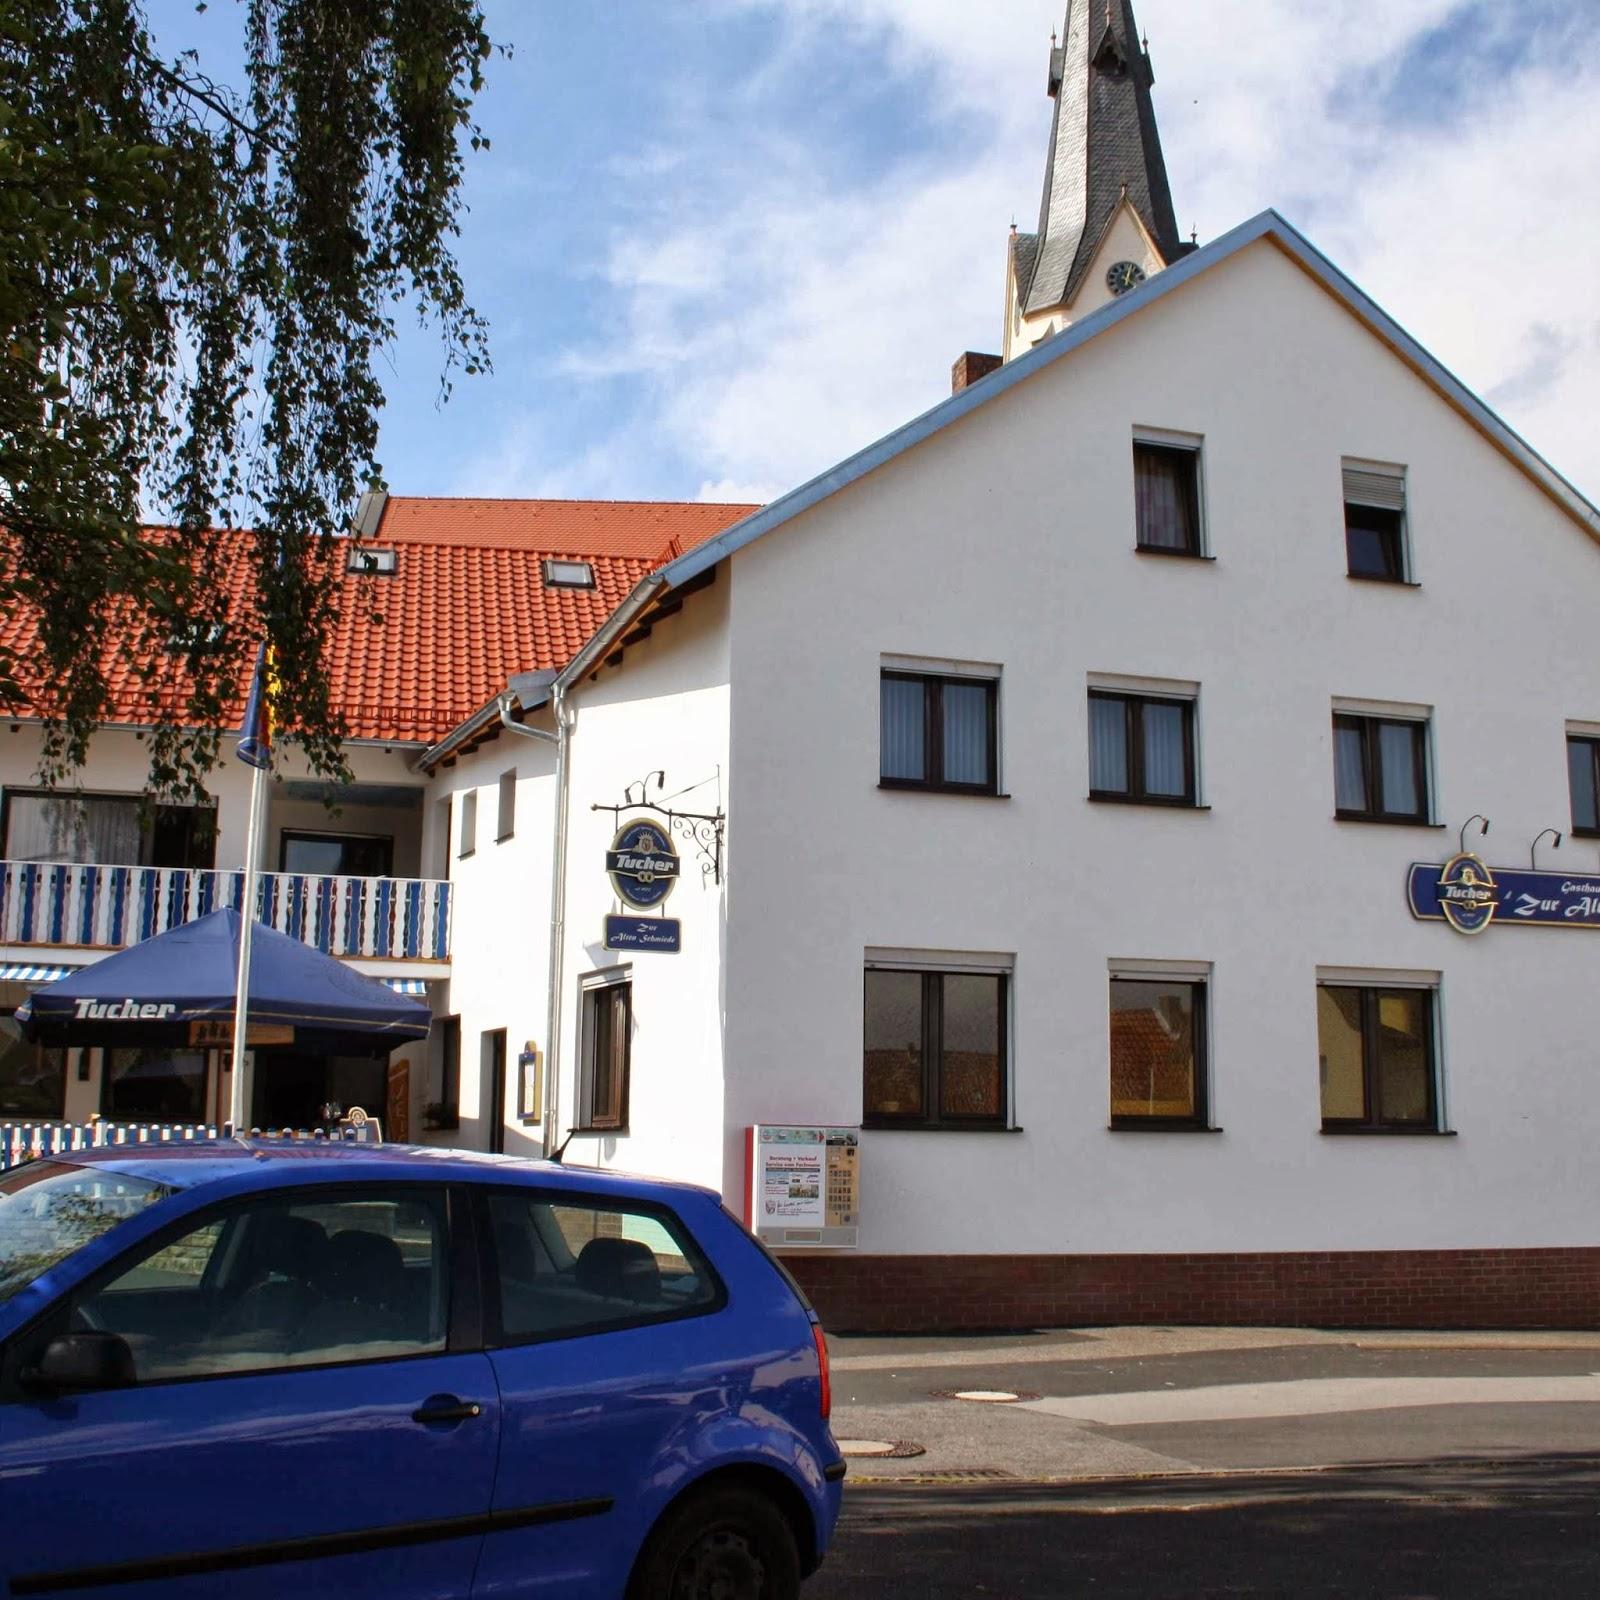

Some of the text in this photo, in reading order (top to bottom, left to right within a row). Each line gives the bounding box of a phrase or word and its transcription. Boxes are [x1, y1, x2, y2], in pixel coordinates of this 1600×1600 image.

[616, 855, 674, 871] Tucher
[1445, 885, 1492, 900] Tucher
[636, 923, 657, 932] Zur
[610, 932, 676, 944] Alten Schmiede
[75, 998, 176, 1019] Tucher
